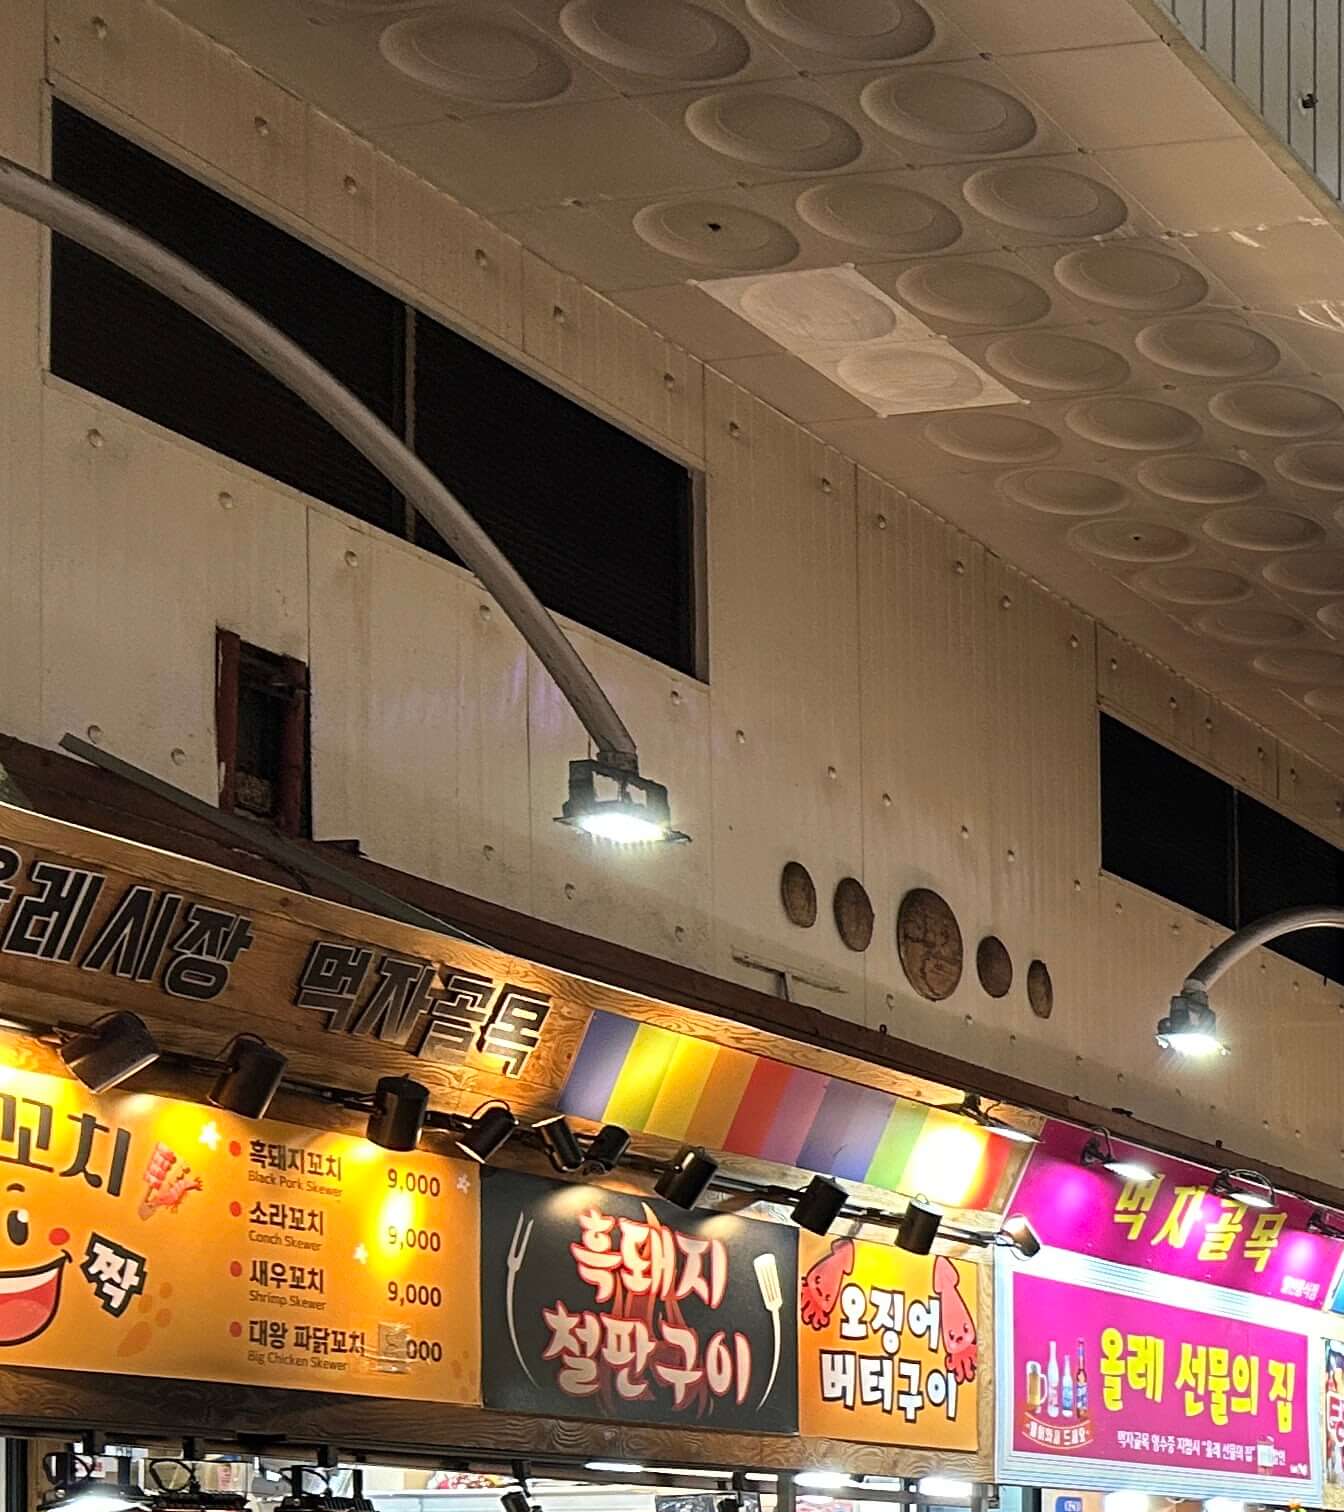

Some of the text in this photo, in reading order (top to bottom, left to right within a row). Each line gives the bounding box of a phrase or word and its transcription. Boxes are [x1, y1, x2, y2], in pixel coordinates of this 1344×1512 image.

[294, 941, 551, 1078] 먹자골목
[0, 1094, 132, 1197] 꼬치
[248, 1139, 343, 1182] 흑돼지꼬치
[387, 1168, 441, 1197] 9,000
[249, 1200, 325, 1236] 소라꼬치
[387, 1224, 441, 1251] 9,000
[1113, 1172, 1288, 1273] 먹자골목
[249, 1230, 322, 1251] Conch Skewer
[571, 1207, 727, 1310] 흑돼지
[249, 1260, 325, 1294] 새우꼬치
[387, 1280, 442, 1307] 9,000
[249, 1290, 327, 1310] Shrimp Skewer
[249, 1319, 366, 1355] 대왕 파닭꼬치
[839, 1288, 943, 1353] 오징어
[248, 1351, 348, 1371] Big Chicken Skewer
[541, 1300, 753, 1404] 철판구이
[818, 1351, 958, 1422] 버터구이
[1100, 1328, 1295, 1433] 올레 선물의 집
